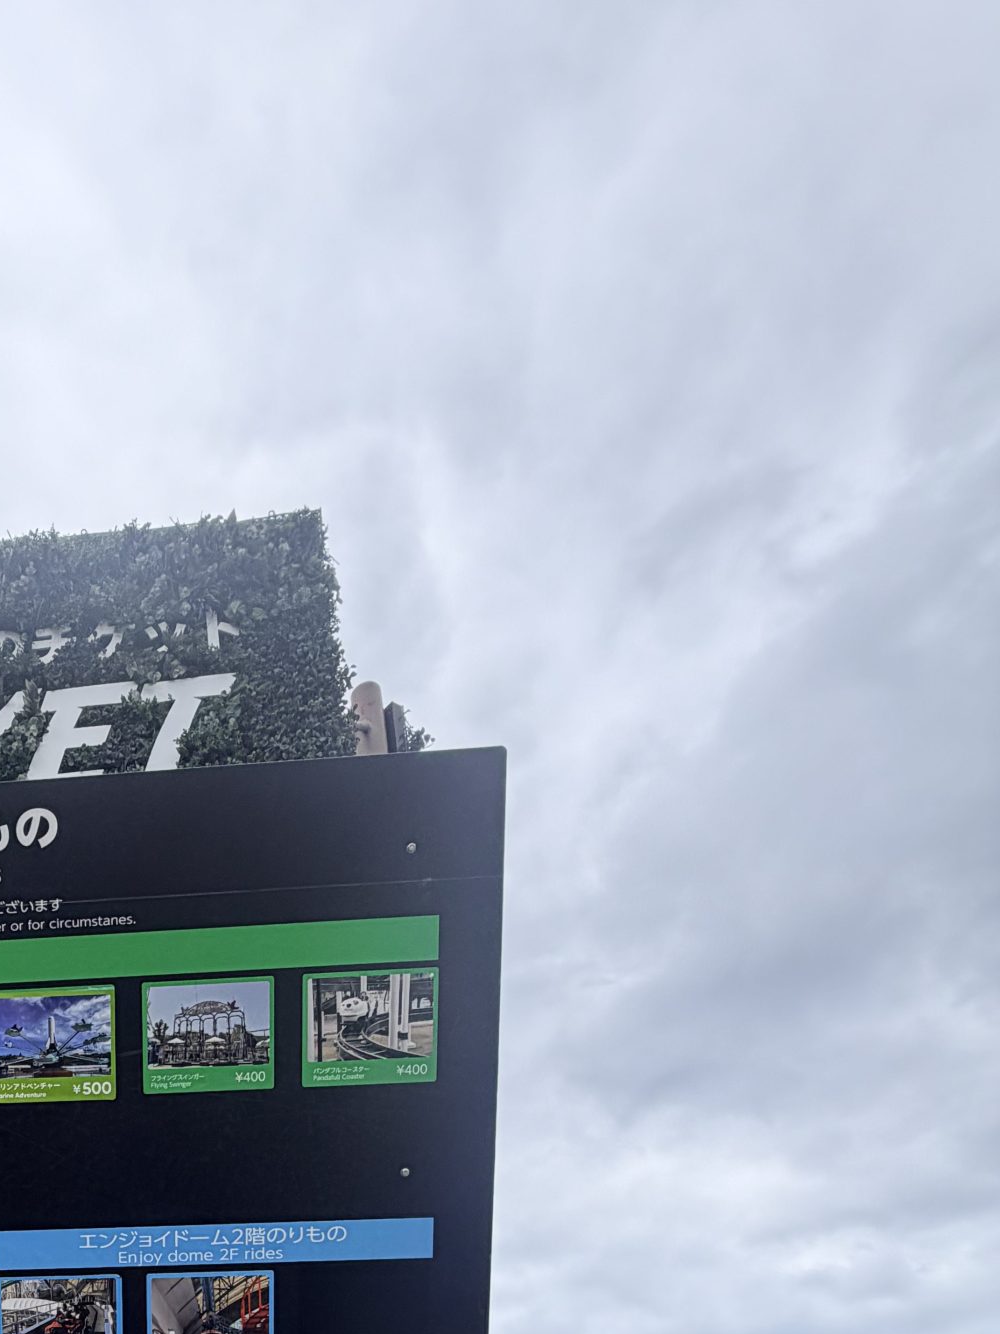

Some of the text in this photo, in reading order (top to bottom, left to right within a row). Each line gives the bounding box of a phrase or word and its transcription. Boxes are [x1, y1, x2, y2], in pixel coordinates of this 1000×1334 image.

[10, 922, 23, 932] or
[27, 919, 44, 930] for
[49, 915, 137, 930] circumstanes.
[235, 1071, 266, 1083] ¥400
[396, 1063, 428, 1076] ¥400
[72, 1081, 112, 1096] ¥500
[79, 1225, 347, 1249] エンジョイドーム2階のりもの
[118, 1247, 284, 1266] Enjoy dome 2F rides
